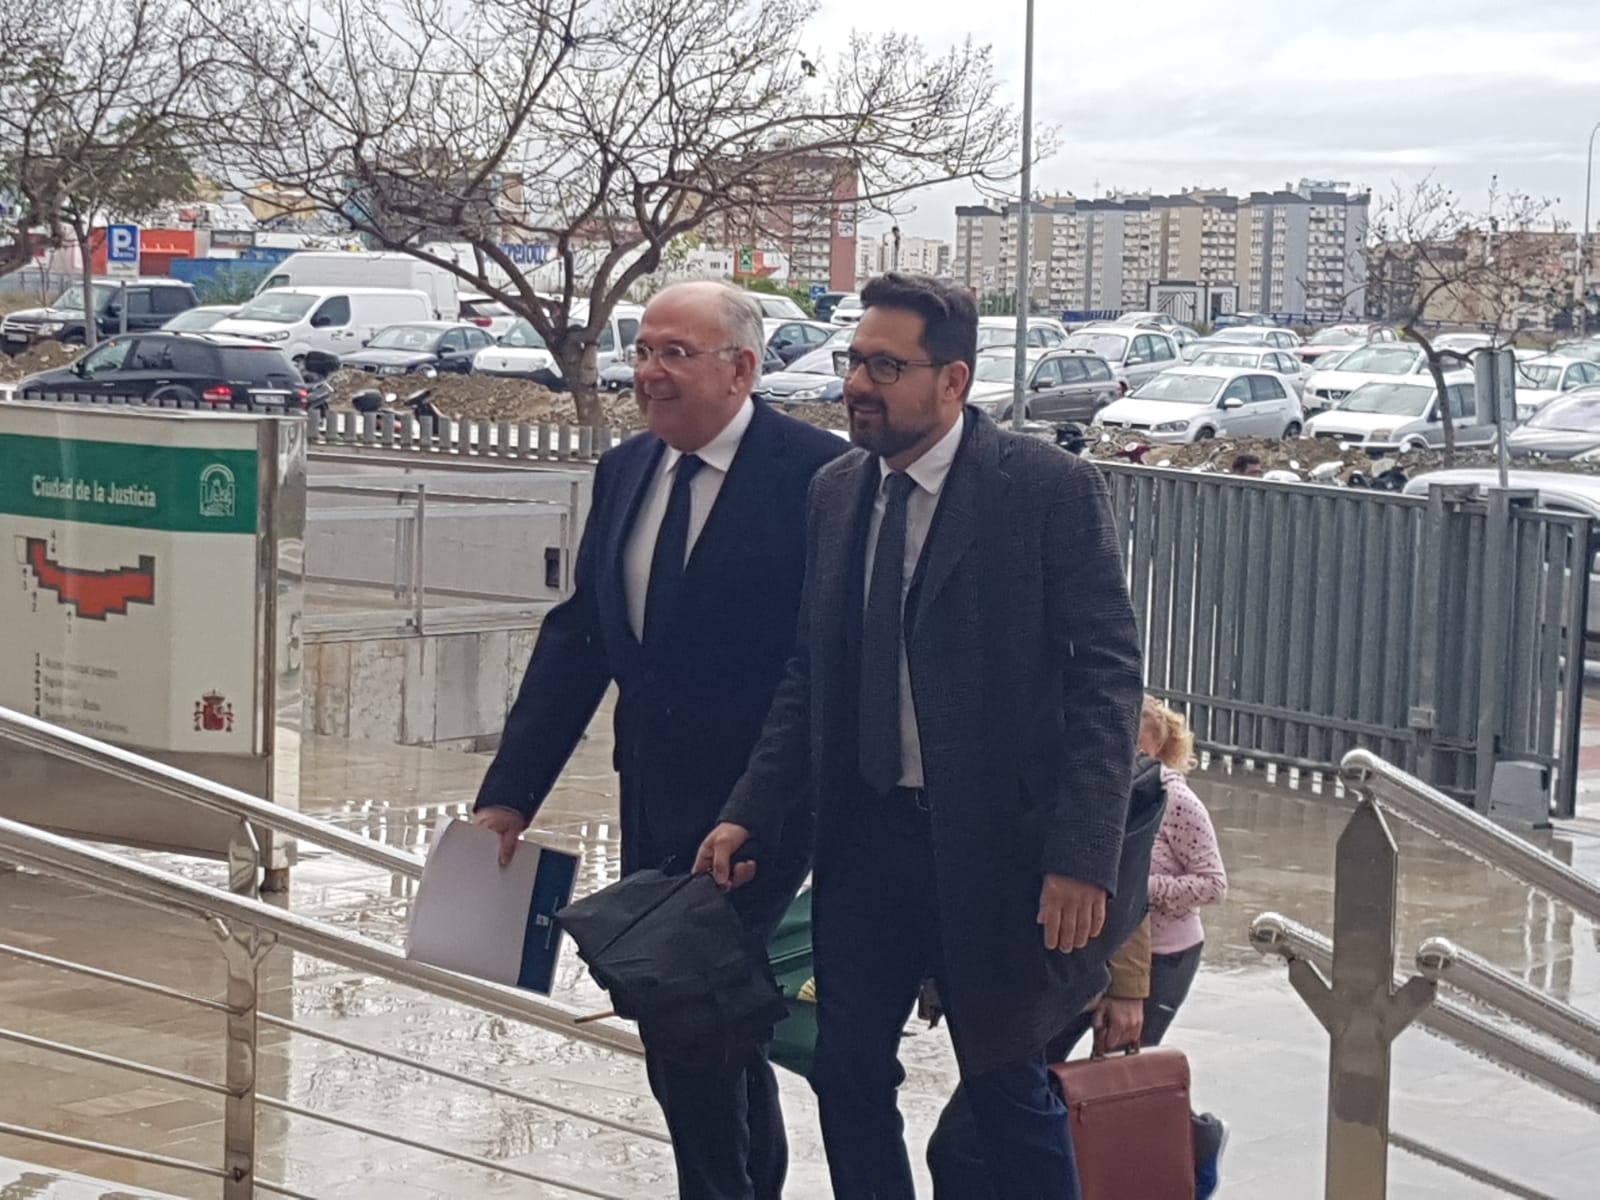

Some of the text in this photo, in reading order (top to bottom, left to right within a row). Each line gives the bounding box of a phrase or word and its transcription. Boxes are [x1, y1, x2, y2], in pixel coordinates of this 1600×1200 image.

[112, 228, 132, 258] P
[32, 475, 156, 507] Ciudad de la Justicia
